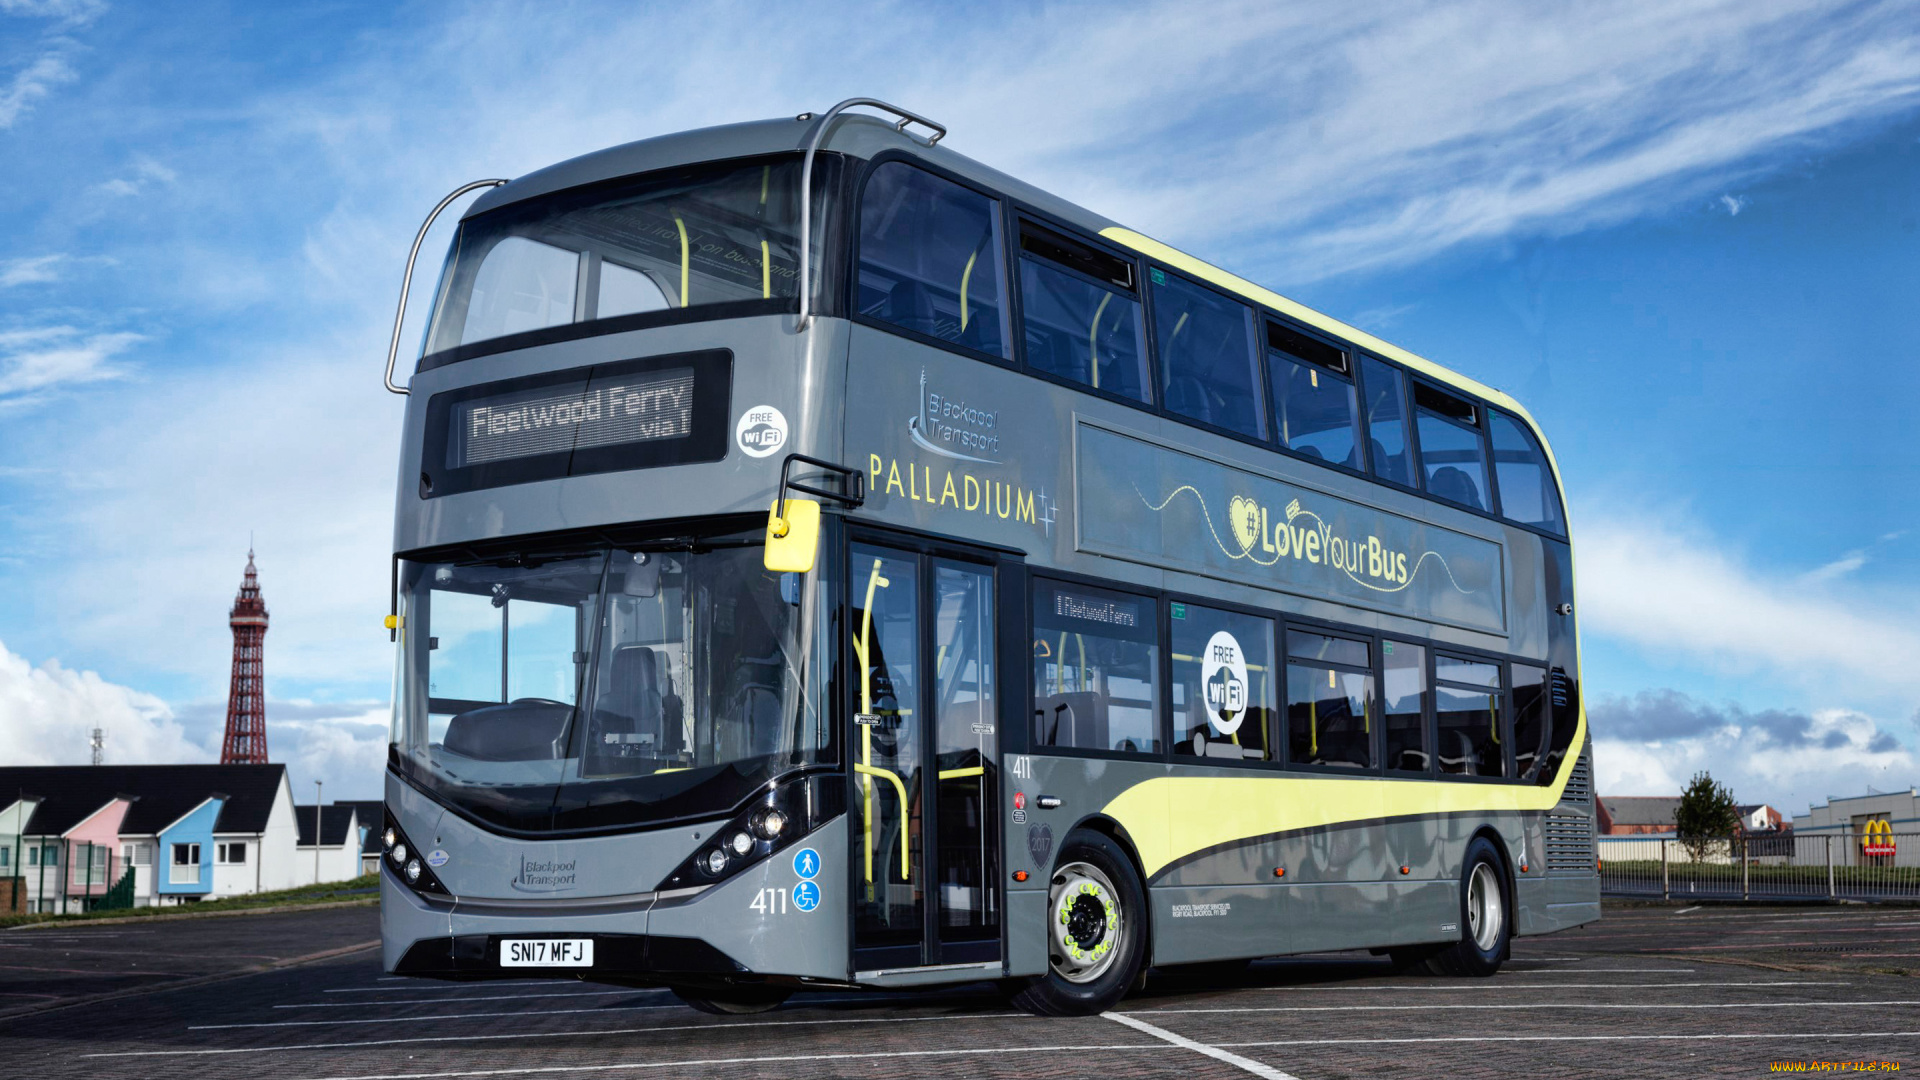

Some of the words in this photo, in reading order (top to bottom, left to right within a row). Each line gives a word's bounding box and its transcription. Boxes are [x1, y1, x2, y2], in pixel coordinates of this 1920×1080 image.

[650, 216, 704, 250] travl
[701, 243, 724, 255] on
[474, 390, 601, 437] Fleetwood
[610, 386, 684, 418] Ferry
[750, 413, 773, 422] FREE
[929, 393, 998, 429] Blackpool
[641, 416, 674, 438] via
[929, 418, 999, 452] Transport
[870, 454, 1036, 525] PALLADIUM
[1065, 597, 1108, 622] Fleetwood
[1109, 604, 1134, 626] Ferry
[1213, 645, 1234, 664] FREE
[1012, 756, 1031, 779] 411
[1031, 838, 1051, 852] 2017
[526, 860, 576, 874] Blackpool
[526, 873, 576, 887] Transport
[749, 888, 787, 915] 411
[511, 942, 546, 961] SN17
[551, 942, 583, 961] MFJ
